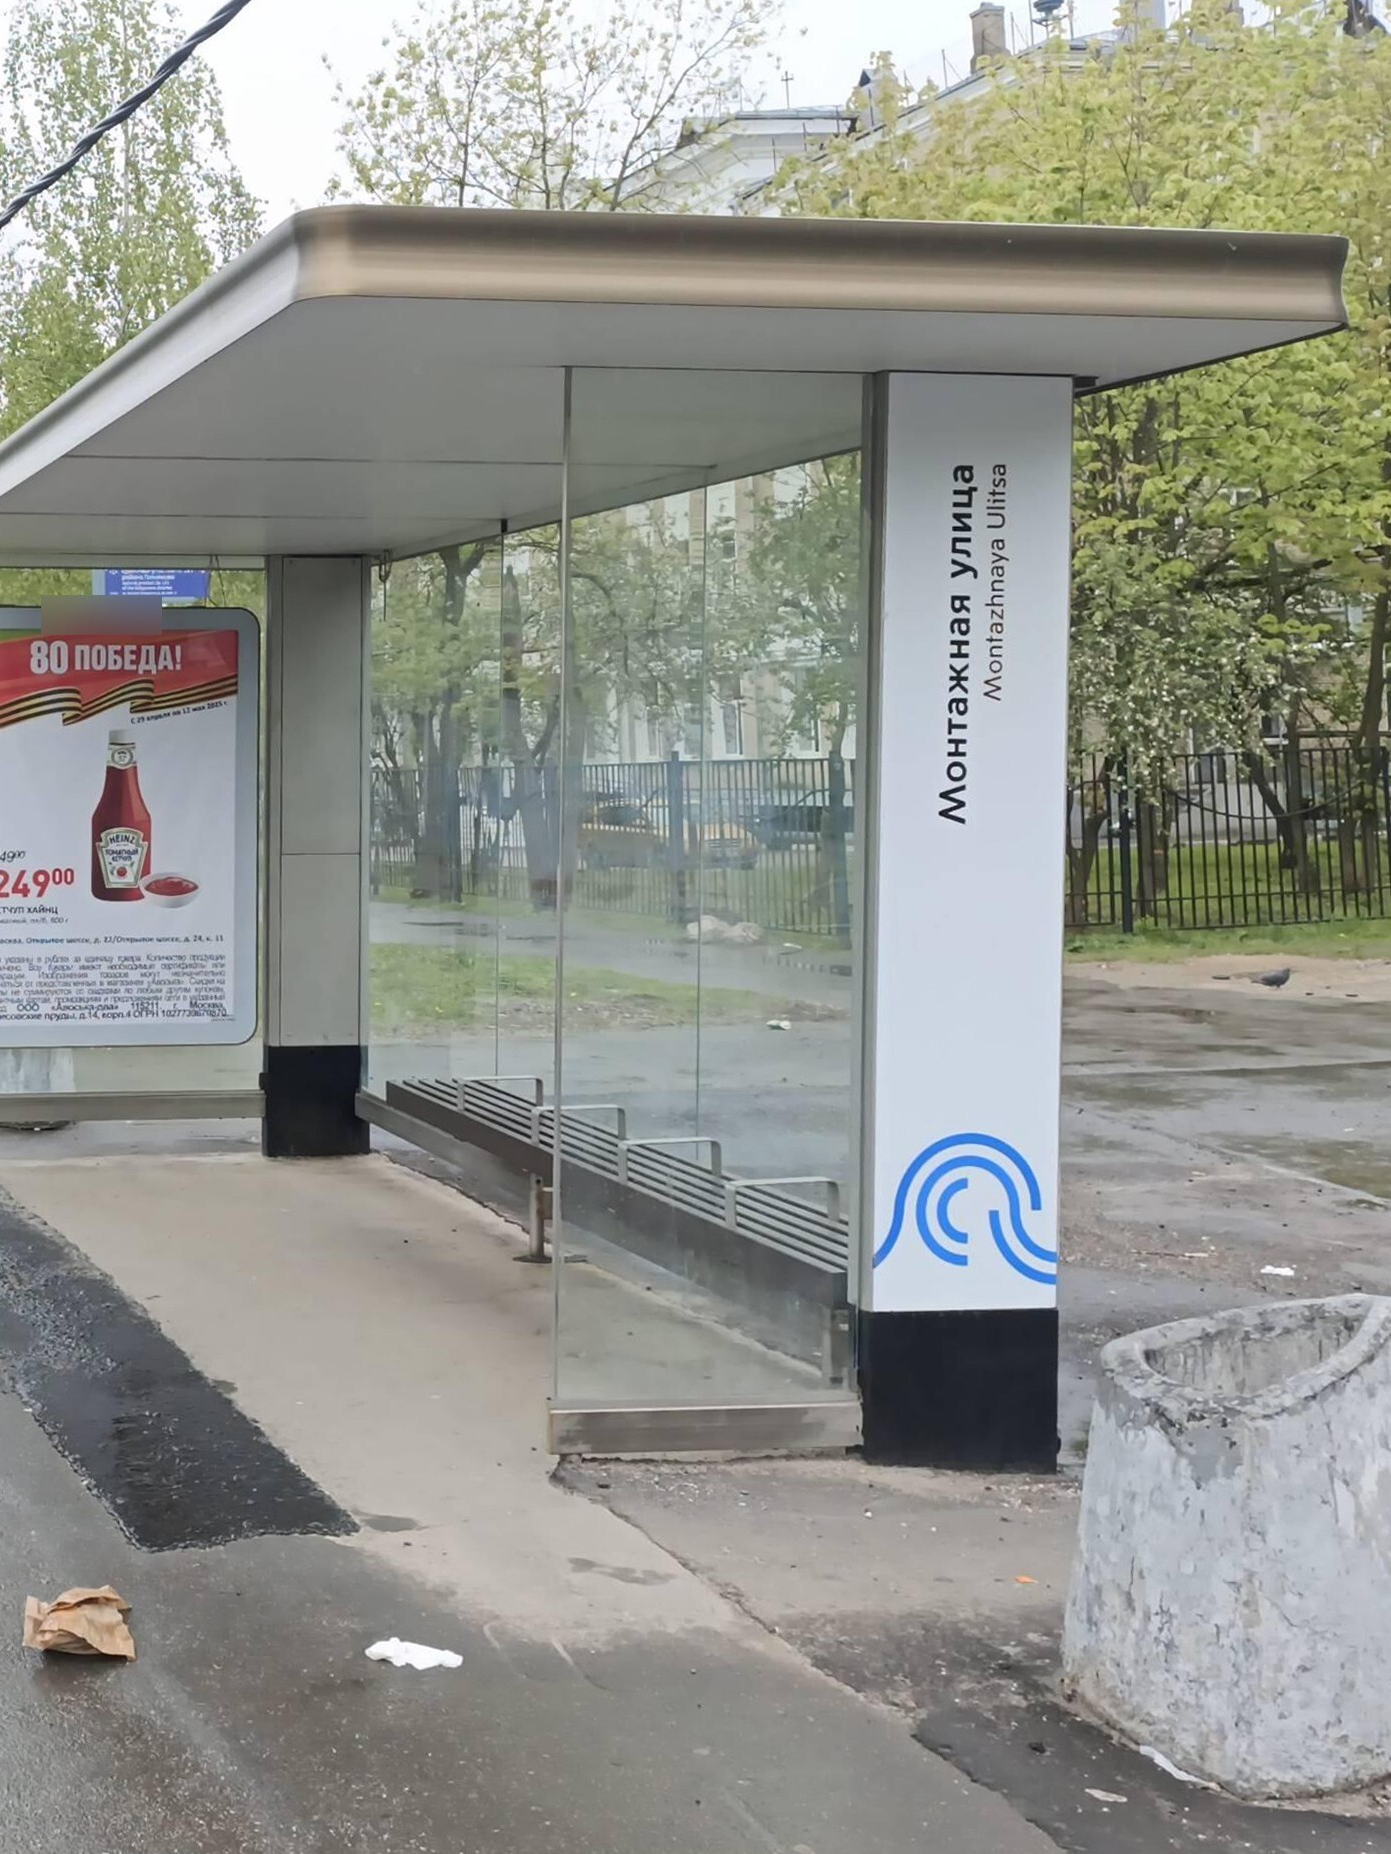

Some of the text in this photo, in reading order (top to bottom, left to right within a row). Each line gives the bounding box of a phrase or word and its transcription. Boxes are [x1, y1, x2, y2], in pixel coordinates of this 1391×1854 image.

[30, 640, 182, 675] 80 ПОБЕДА!
[938, 464, 978, 824] Монтажная улица
[983, 464, 1009, 701] Montazhnaya Ulitsa
